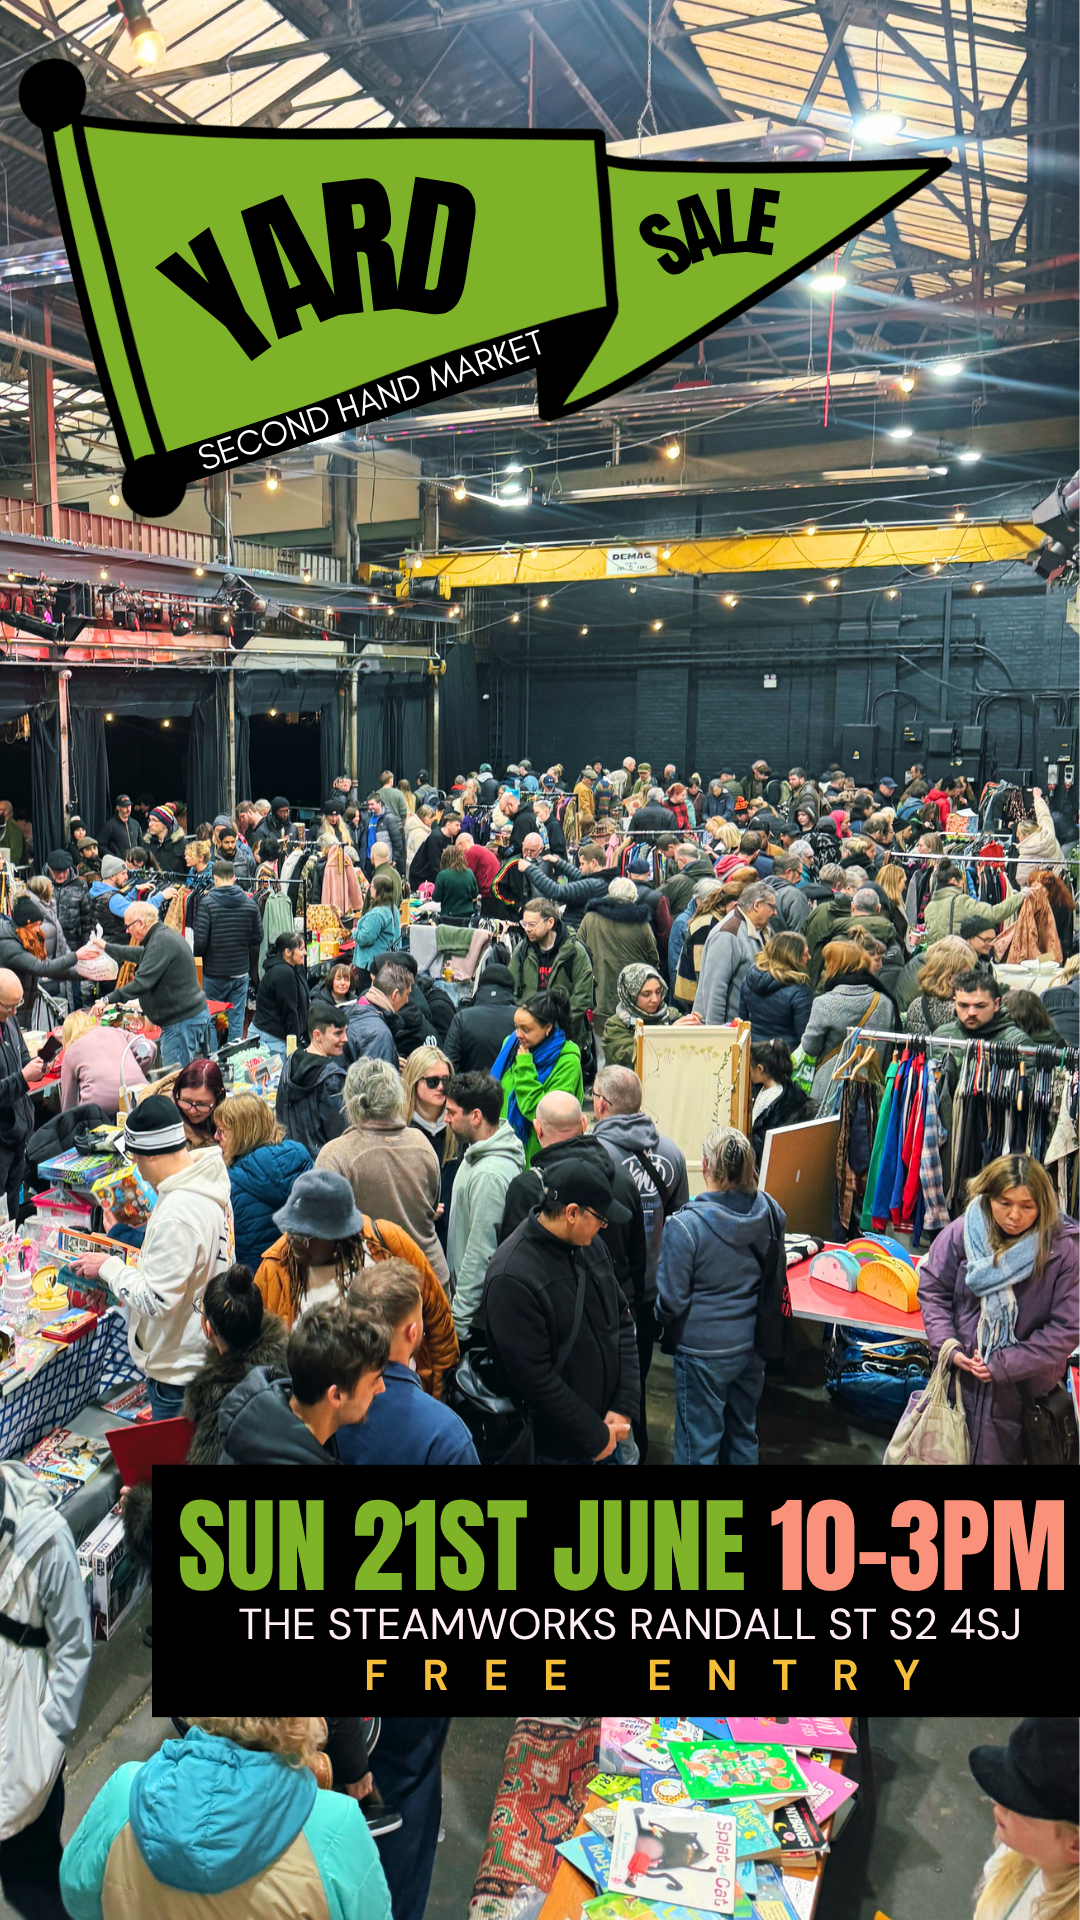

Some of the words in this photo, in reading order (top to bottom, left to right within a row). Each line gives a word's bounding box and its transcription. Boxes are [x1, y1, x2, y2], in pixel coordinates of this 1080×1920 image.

[612, 552, 652, 561] DEMAG
[32, 1431, 69, 1466] MANGA
[715, 1820, 733, 1863] Splat
[784, 1803, 814, 1847] NYBONES
[713, 1877, 731, 1907] Cat
